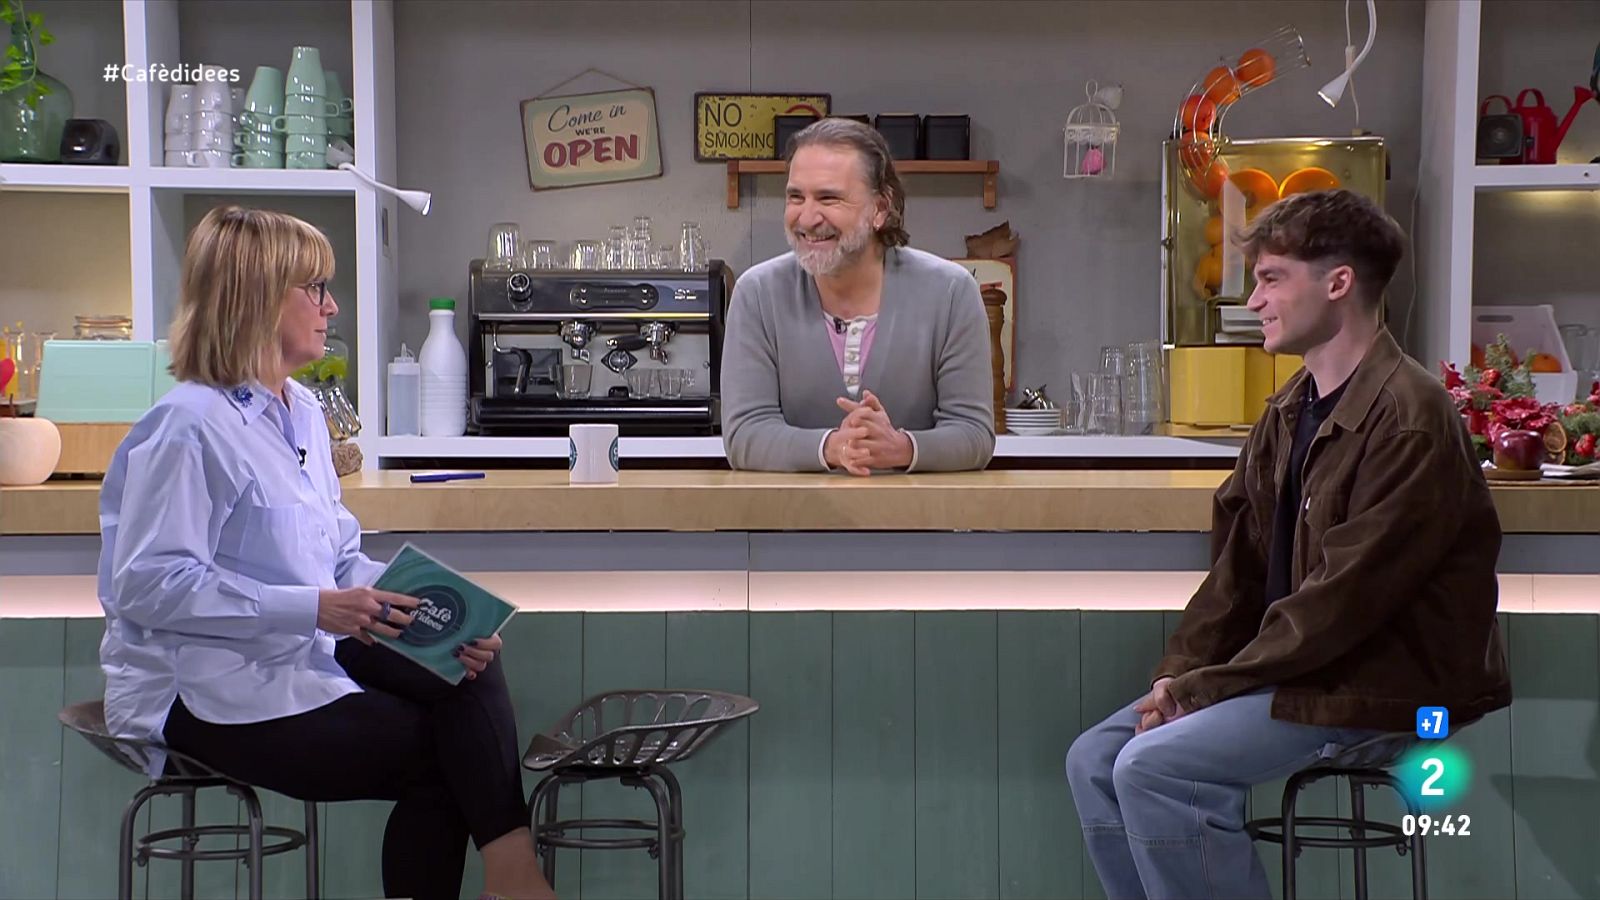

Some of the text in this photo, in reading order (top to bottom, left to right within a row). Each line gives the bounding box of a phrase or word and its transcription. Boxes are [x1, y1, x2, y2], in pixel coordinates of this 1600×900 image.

[548, 104, 627, 132] Come in
[704, 102, 742, 127] NO
[575, 126, 606, 136] WE'RE
[543, 134, 638, 168] OPEN
